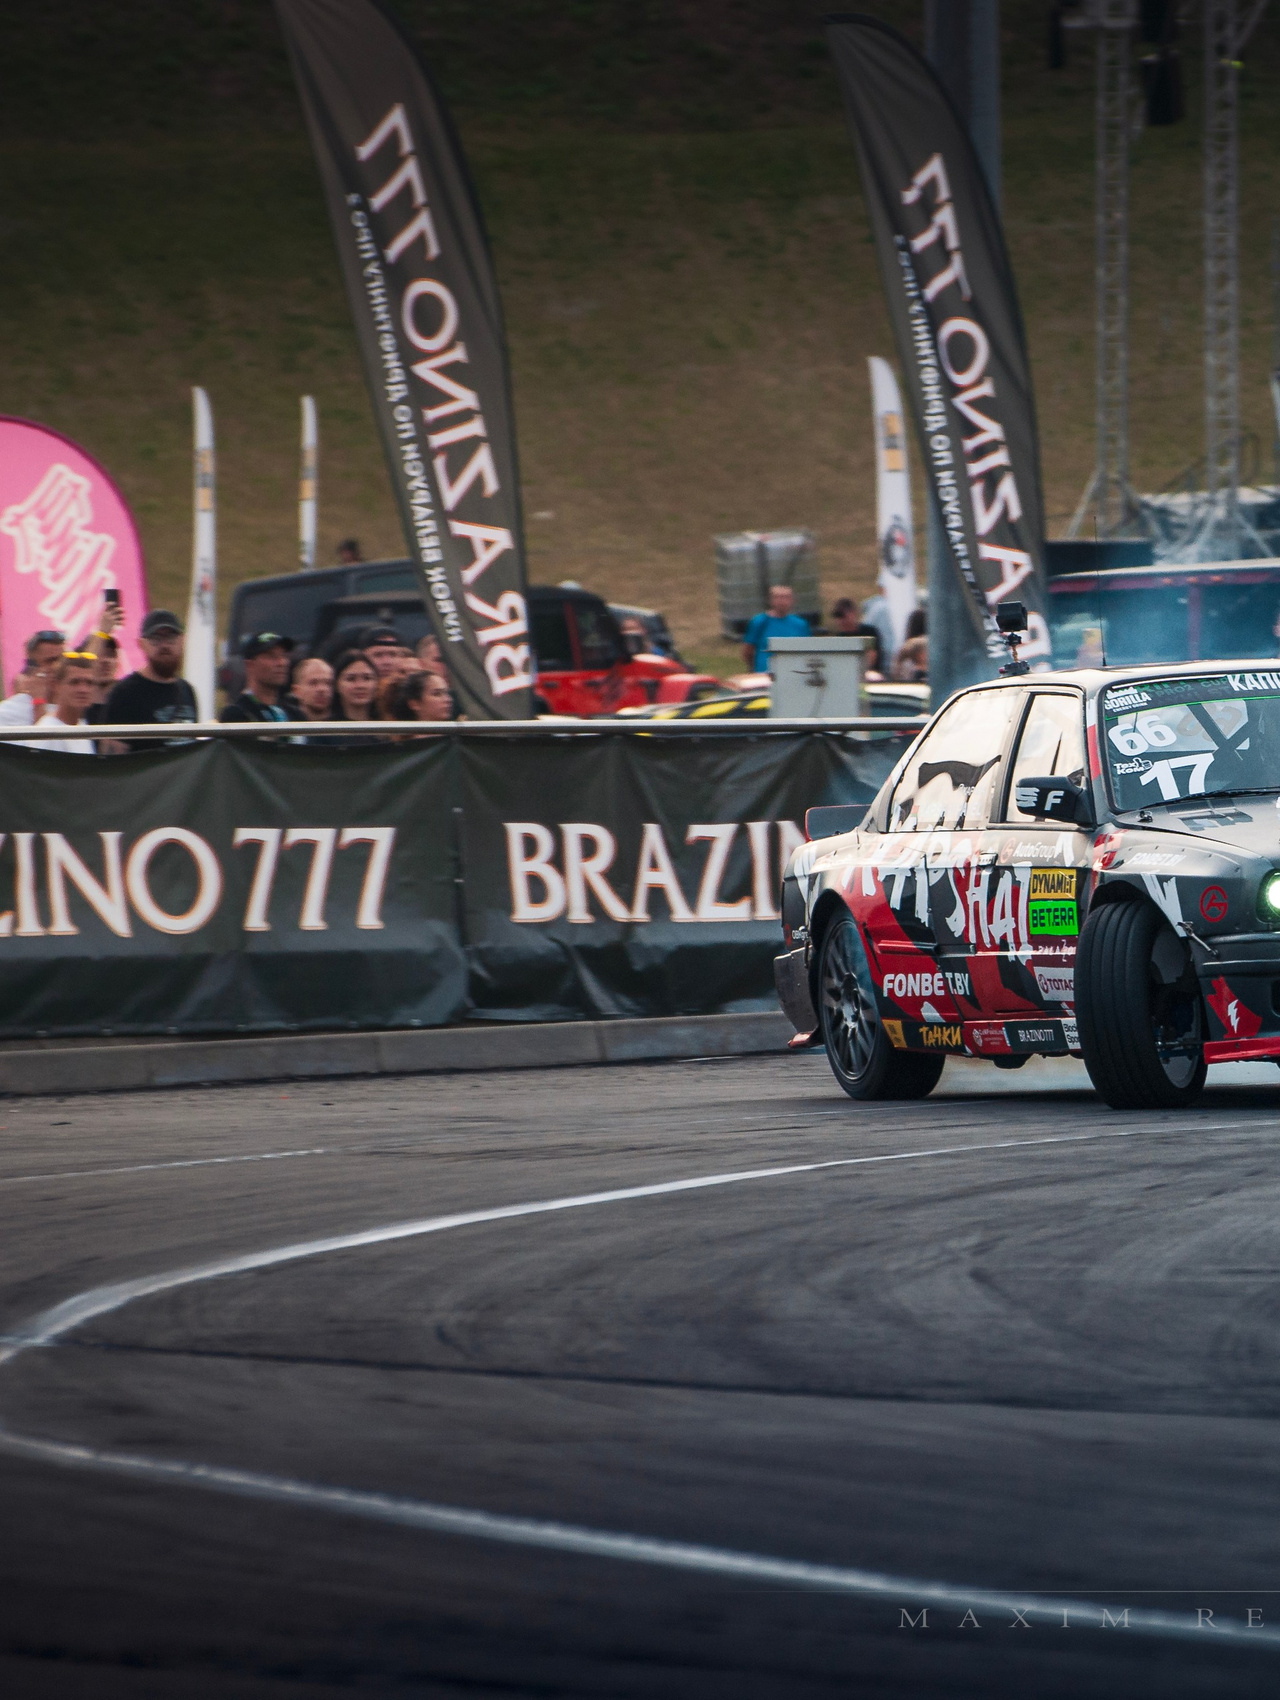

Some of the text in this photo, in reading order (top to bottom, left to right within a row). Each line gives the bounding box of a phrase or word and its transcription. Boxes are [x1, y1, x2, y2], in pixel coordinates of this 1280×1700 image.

[1104, 692, 1152, 710] GORILLA
[1108, 715, 1177, 756] 66
[1139, 753, 1215, 801] 17
[0, 825, 223, 939] INO
